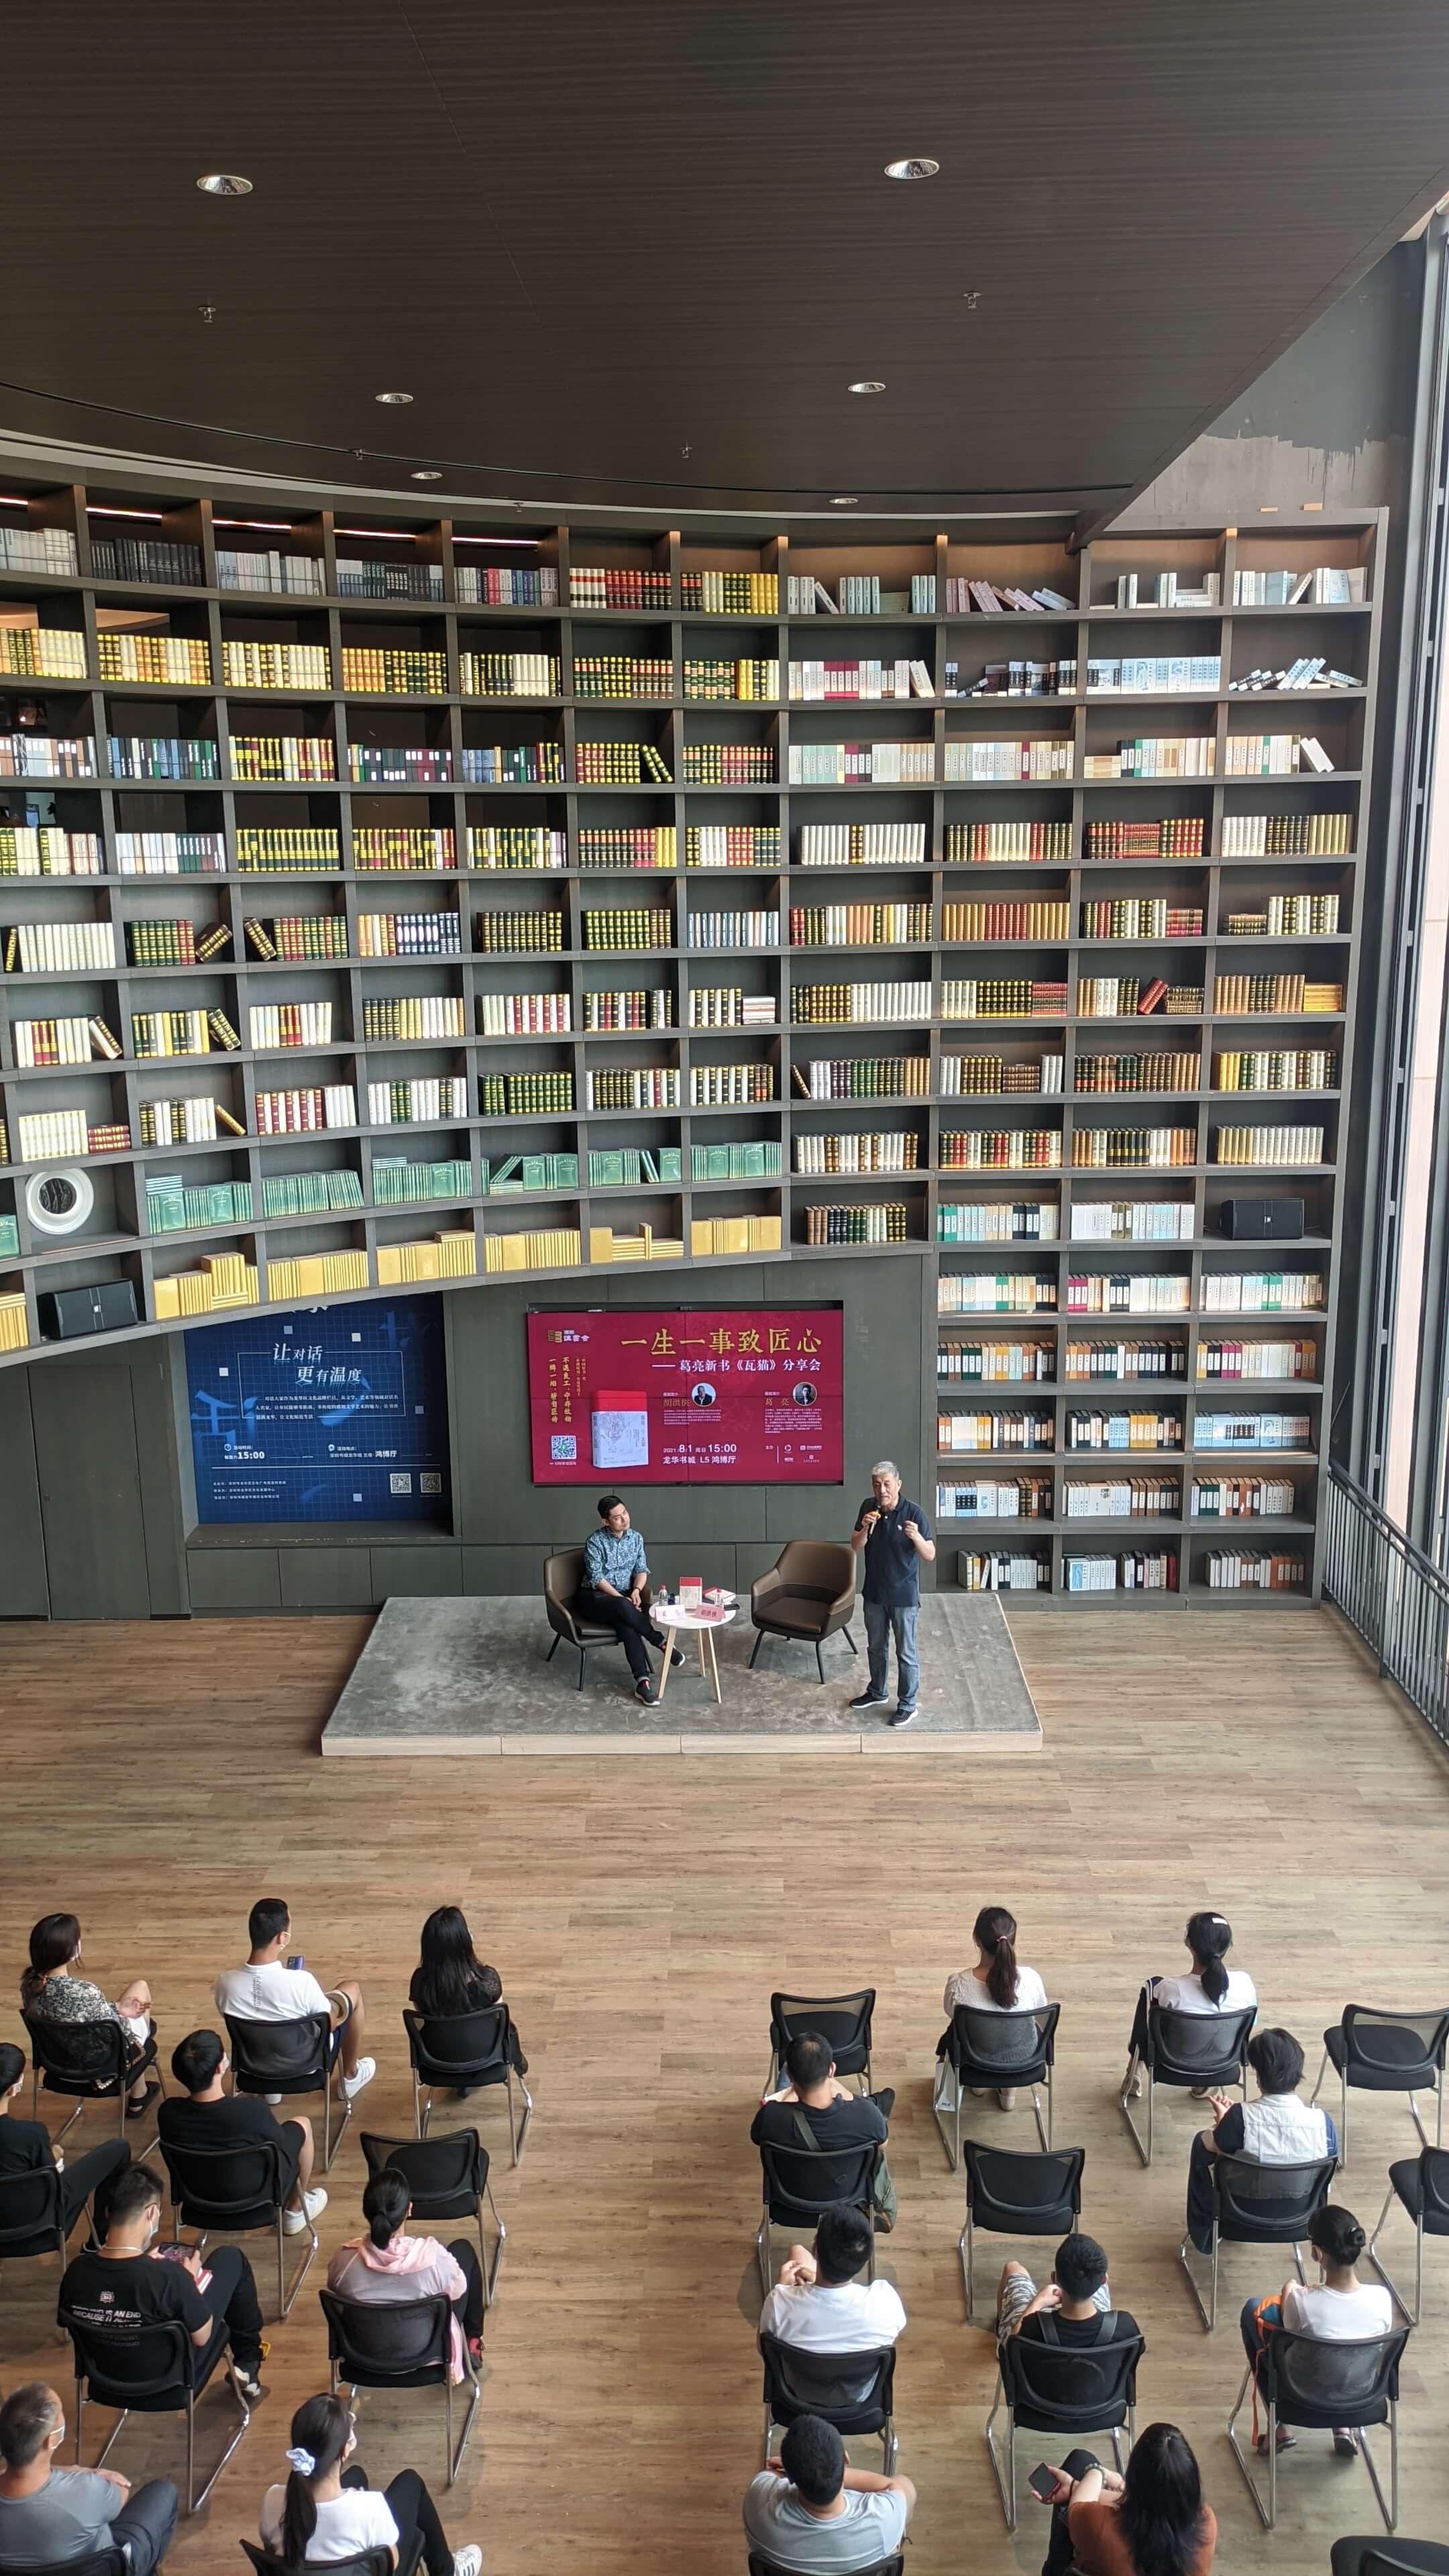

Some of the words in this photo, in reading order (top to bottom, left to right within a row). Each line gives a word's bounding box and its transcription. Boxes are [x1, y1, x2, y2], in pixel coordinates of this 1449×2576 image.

[621, 1328, 822, 1356] 一生一事致匠心
[272, 1342, 323, 1361] 让对话
[297, 1365, 362, 1385] 更有温度
[708, 1444, 737, 1452] 15:00
[663, 1456, 696, 1464] 龙华书城
[712, 1455, 736, 1464] 鸿博厅
[113, 2310, 125, 2318] AN
